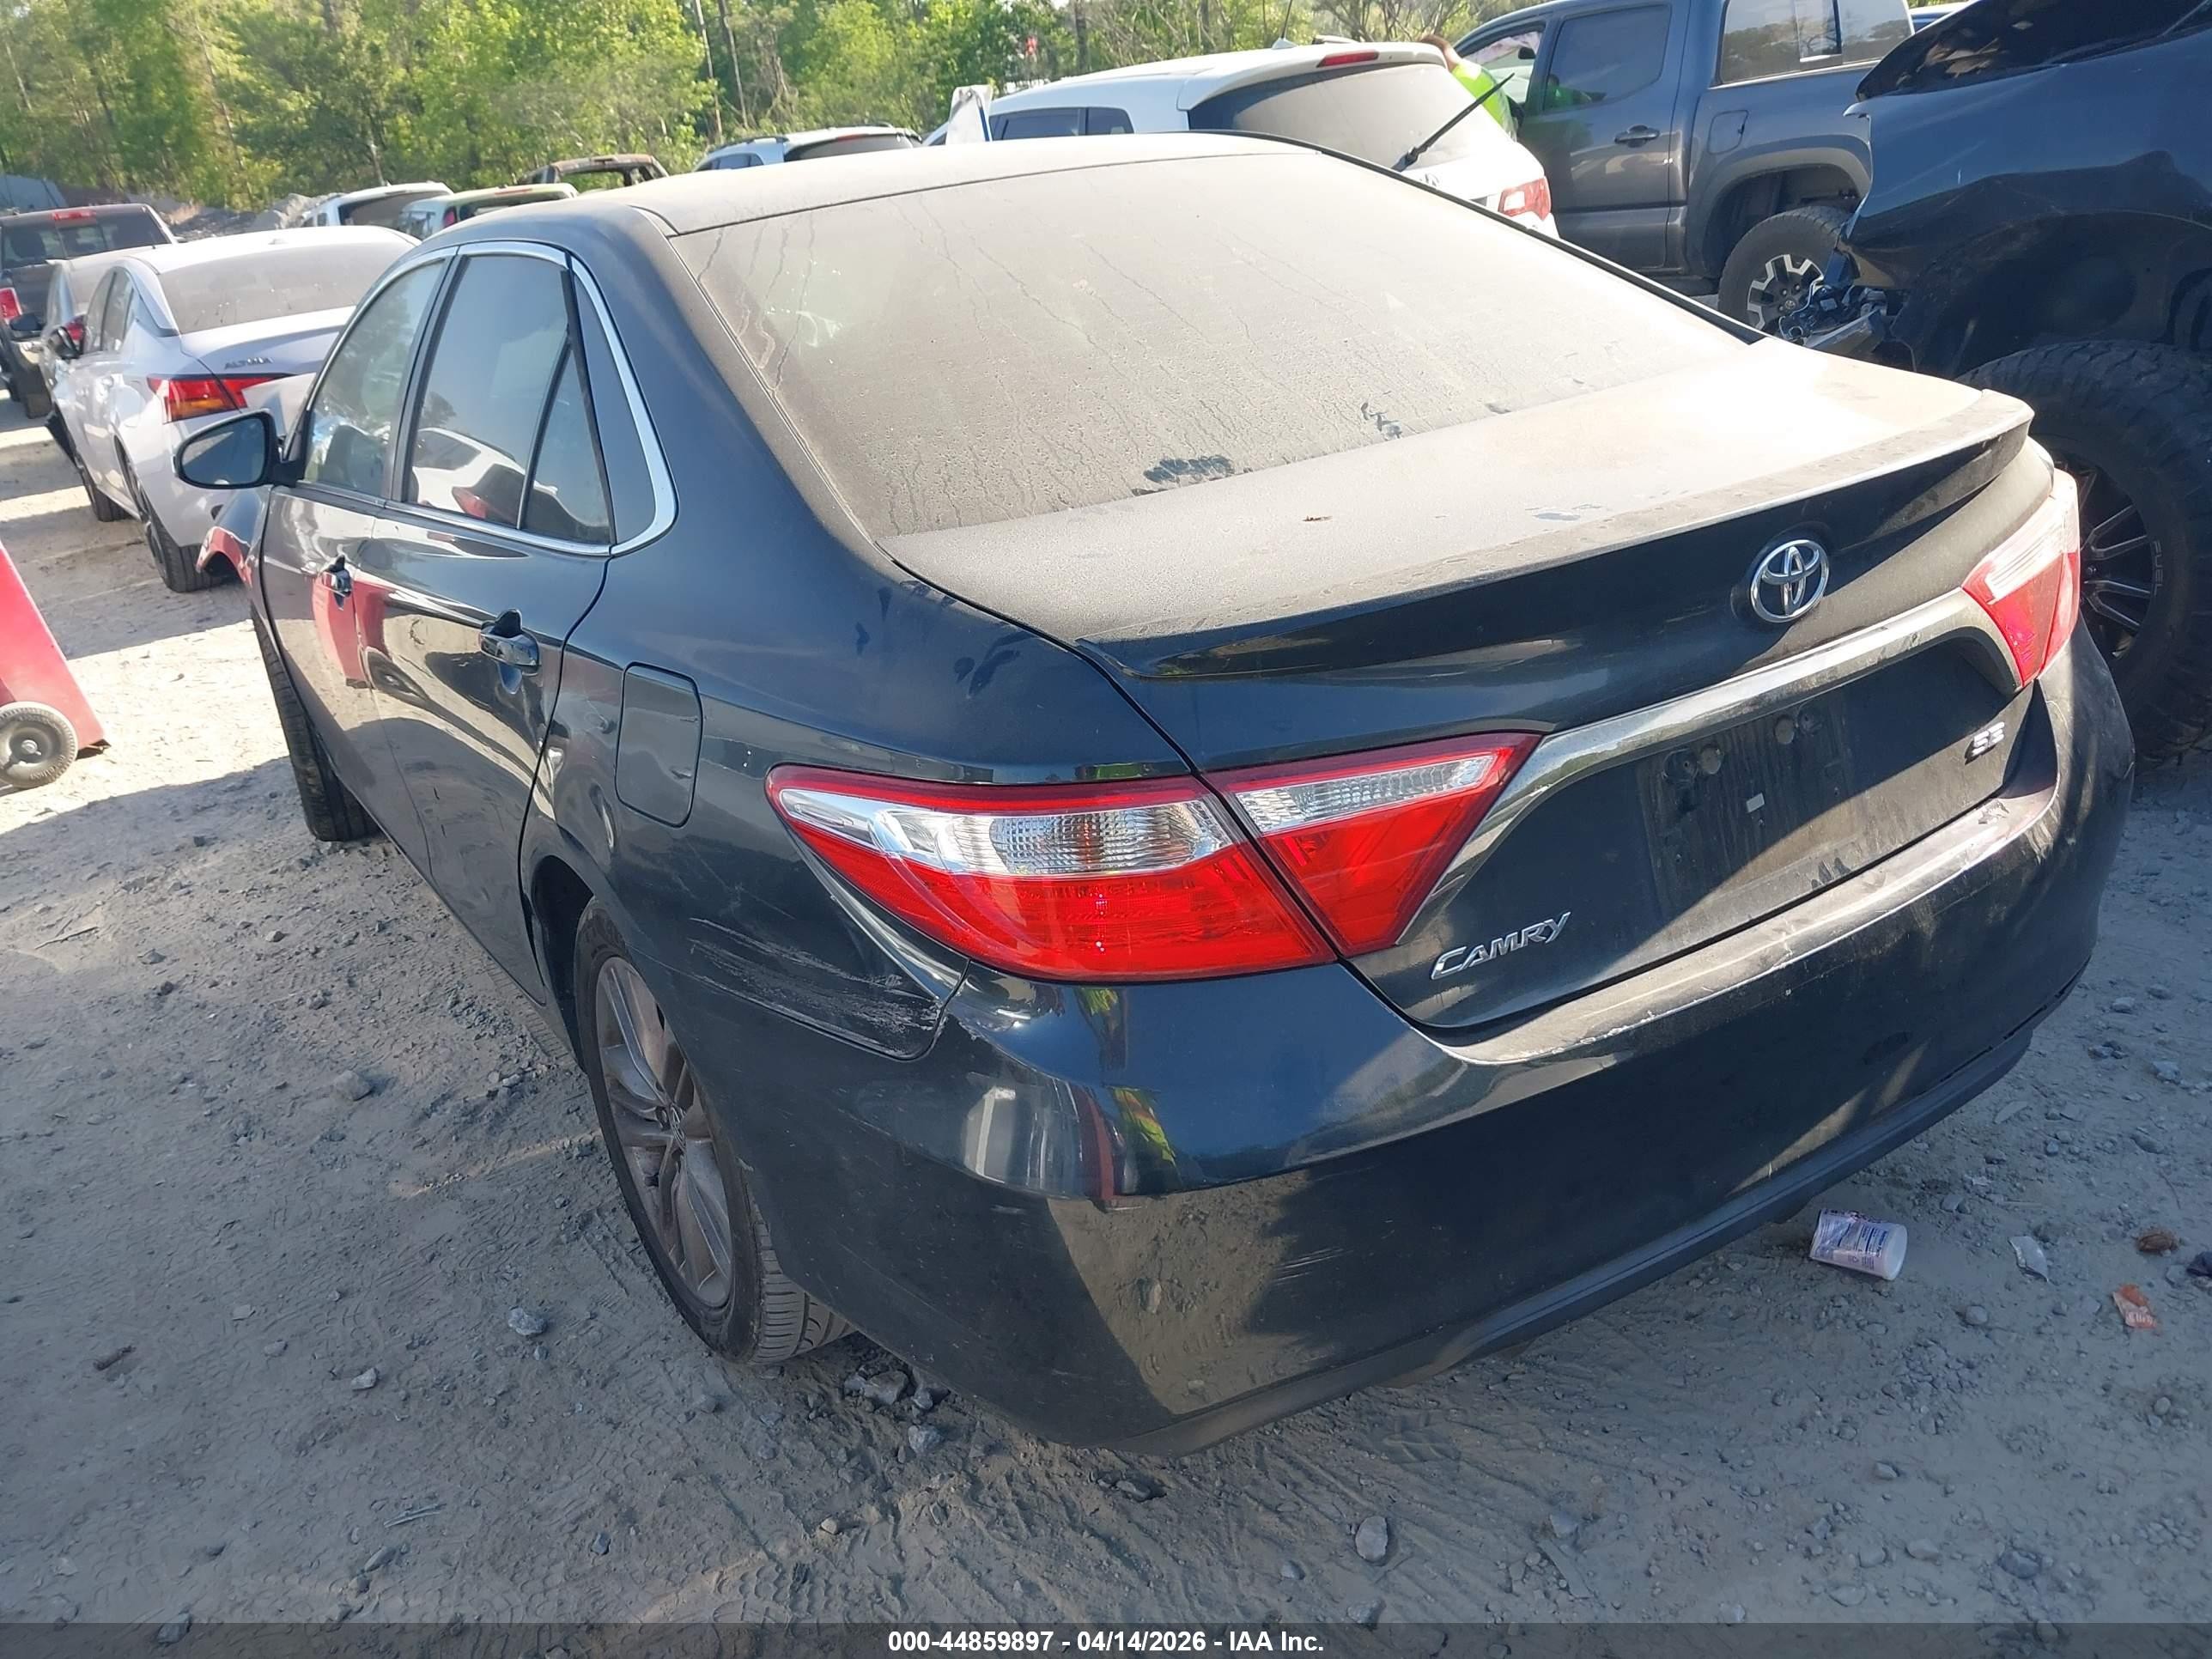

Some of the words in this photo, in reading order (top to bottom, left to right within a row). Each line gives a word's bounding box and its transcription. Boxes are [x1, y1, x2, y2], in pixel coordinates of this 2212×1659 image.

[2153, 539, 2163, 596] FUEL
[1970, 721, 2005, 757] SE
[1431, 911, 1571, 980] CAMRY
